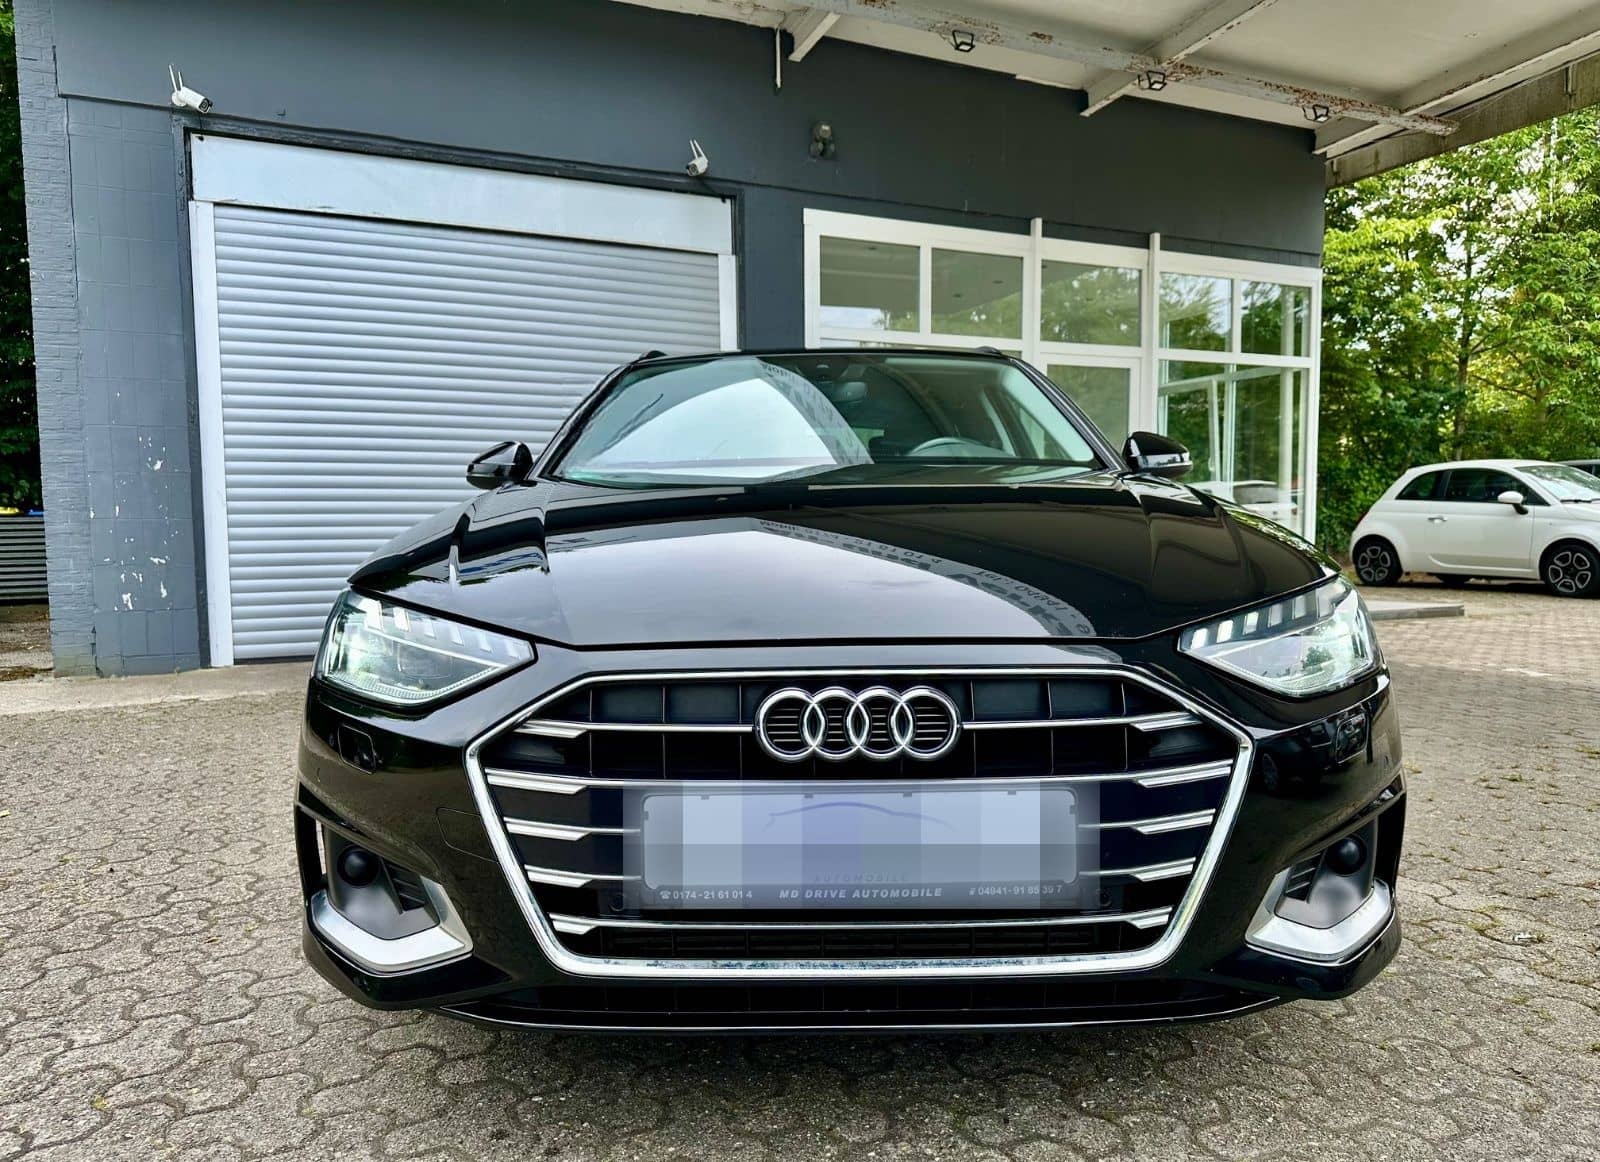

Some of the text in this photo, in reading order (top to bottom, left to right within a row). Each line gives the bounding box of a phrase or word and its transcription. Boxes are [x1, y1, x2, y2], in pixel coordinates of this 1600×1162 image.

[778, 887, 943, 899] MD DRIVE AUTOMOBILE
